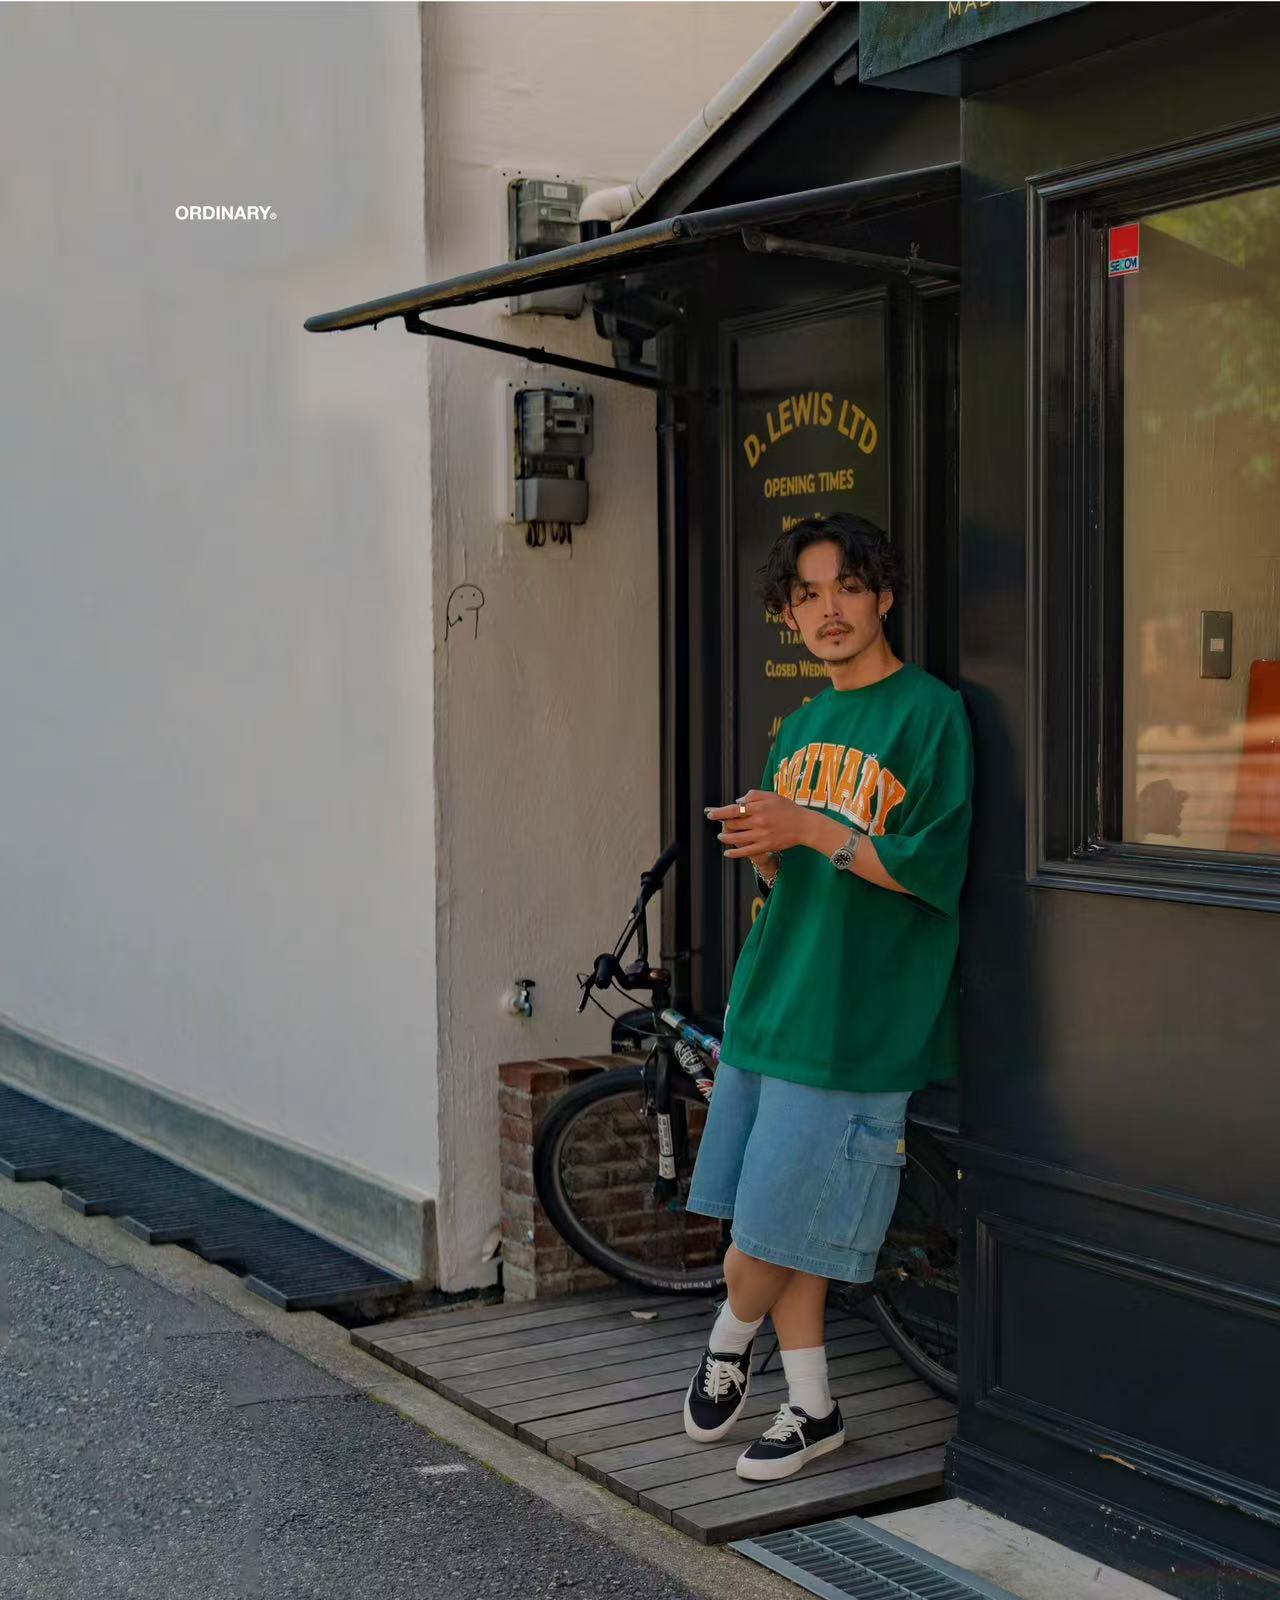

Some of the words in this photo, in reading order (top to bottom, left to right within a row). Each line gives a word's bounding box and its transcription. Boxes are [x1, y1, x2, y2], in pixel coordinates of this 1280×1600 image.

[1110, 257, 1137, 272] SECOM
[743, 433, 767, 469] D.
[766, 391, 833, 443] LEWIS
[837, 399, 878, 454] LTD
[763, 473, 816, 498] OPENING
[818, 468, 854, 492] TIMES
[773, 742, 906, 836] INARY
